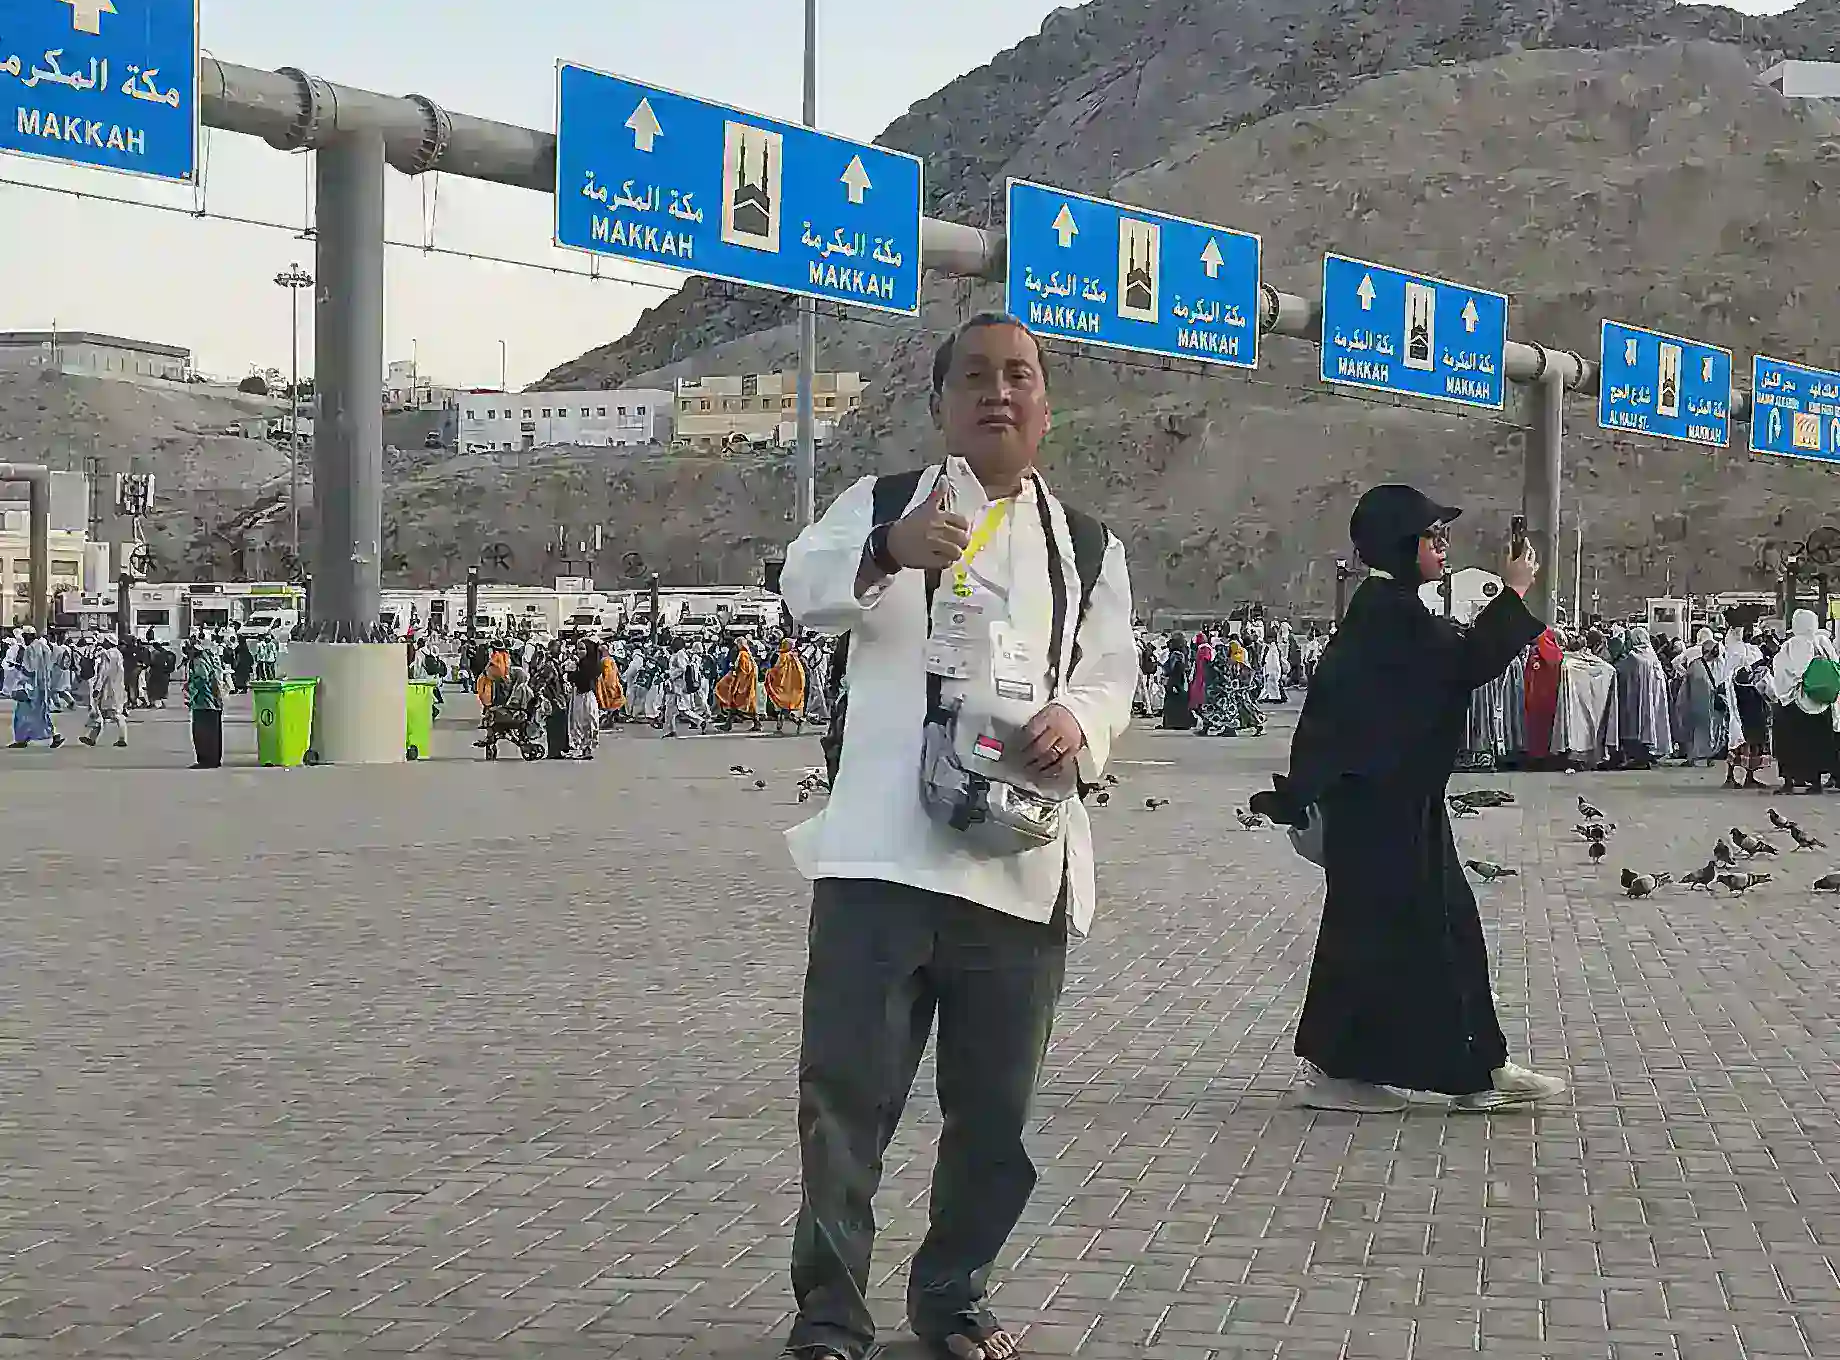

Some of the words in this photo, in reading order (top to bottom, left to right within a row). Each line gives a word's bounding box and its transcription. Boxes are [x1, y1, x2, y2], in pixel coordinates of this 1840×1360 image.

[0, 48, 108, 92] المكرم
[121, 64, 180, 108] مكة
[17, 106, 145, 155] MAKKAH
[582, 170, 660, 212] المكرمة
[668, 189, 704, 224] مكة
[592, 214, 694, 259] MAKKAH
[801, 220, 866, 261] المكرمة
[872, 237, 902, 268] مكة
[809, 260, 895, 300] MAKKAH
[1024, 266, 1077, 299] المكرمة
[1081, 277, 1107, 304] مكة
[1030, 301, 1100, 333] MAKKAH
[1171, 294, 1220, 324] المكرمة
[1223, 304, 1246, 328] مكة
[1177, 327, 1239, 356] MAKKAH
[1334, 326, 1373, 353] المكرمة
[1375, 334, 1394, 357] مكة
[1338, 356, 1389, 383] MAKKAH
[1442, 347, 1477, 372] المكرمة
[1478, 354, 1495, 375] مكة
[1446, 376, 1490, 400] MAKKAH
[1687, 424, 1722, 443] MAKKAH
